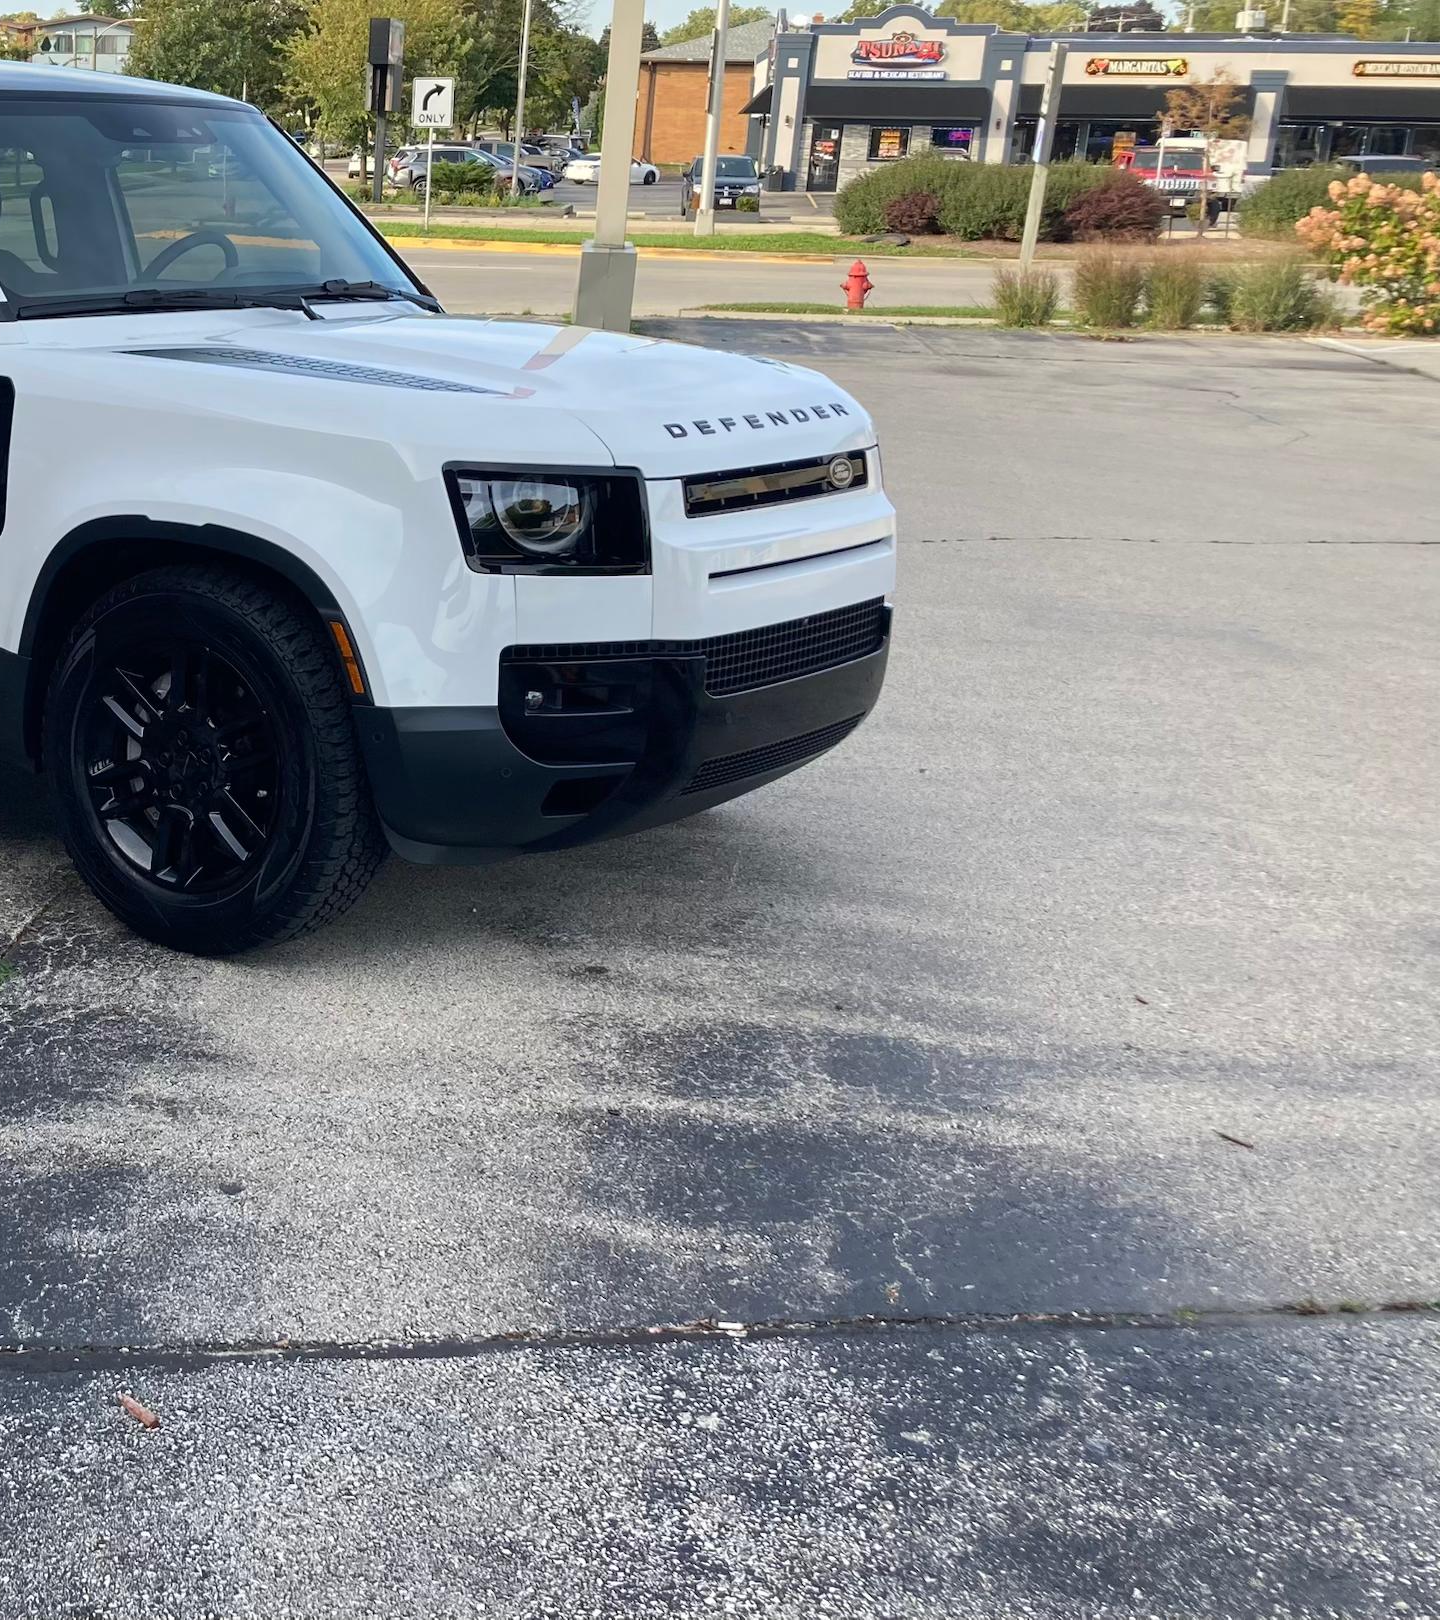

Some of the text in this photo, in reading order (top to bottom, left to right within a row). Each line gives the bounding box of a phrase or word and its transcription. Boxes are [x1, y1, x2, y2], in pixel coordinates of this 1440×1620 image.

[1108, 61, 1167, 73] MARGARITAS
[880, 71, 907, 79] MEXICAN
[907, 71, 945, 79] RESTAURANT
[418, 113, 446, 123] ONLY
[663, 403, 849, 438] DEFENDER
